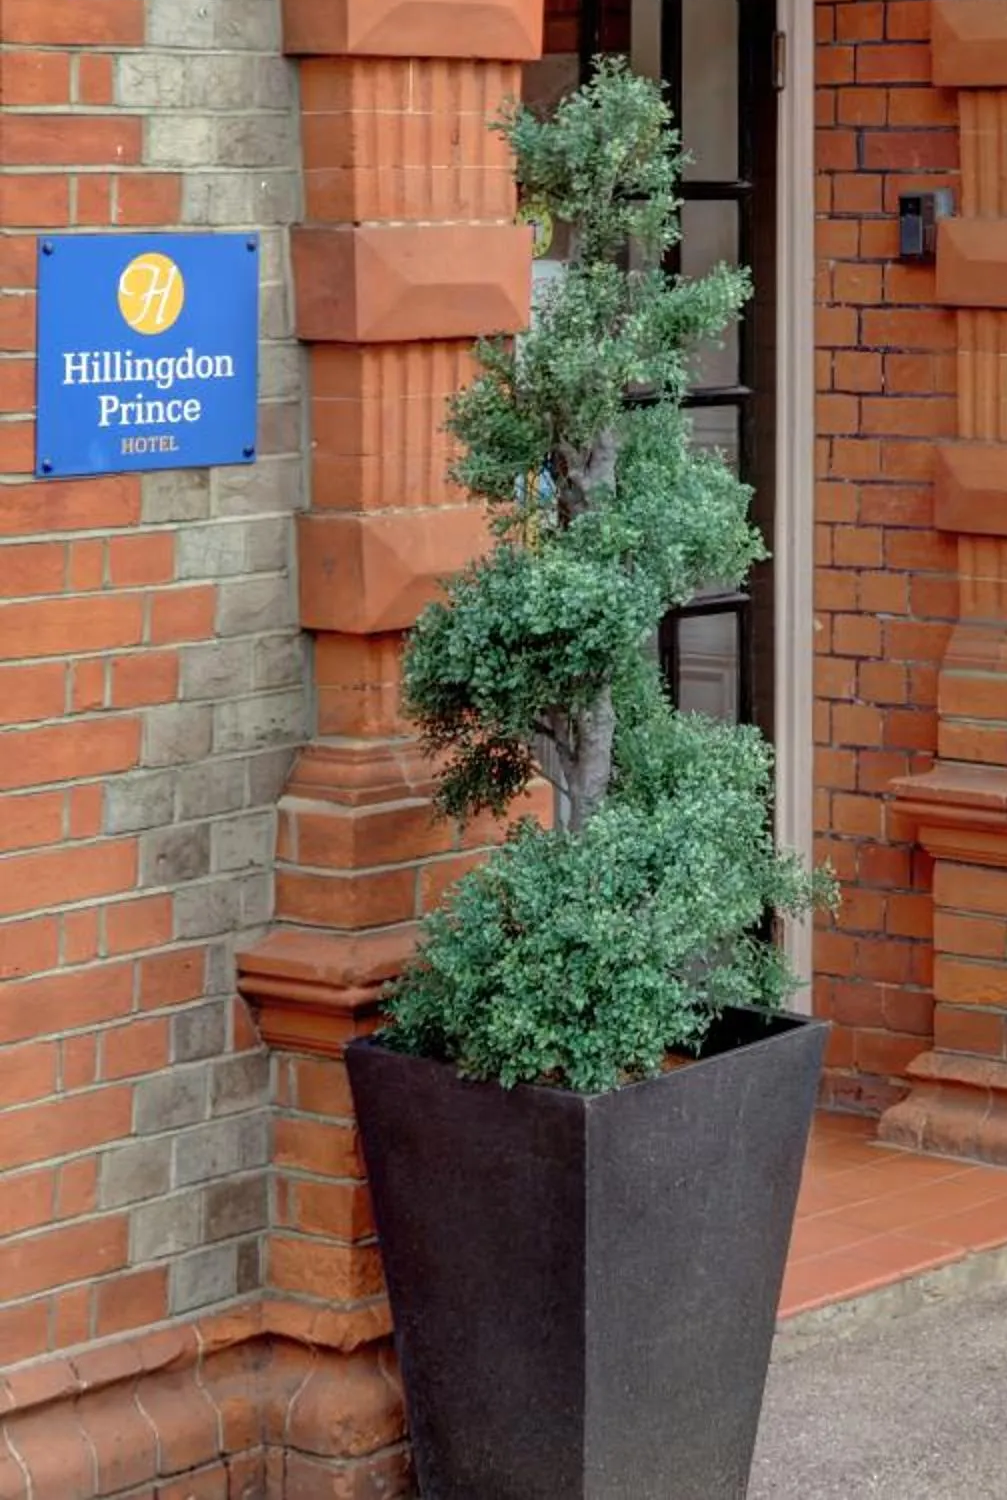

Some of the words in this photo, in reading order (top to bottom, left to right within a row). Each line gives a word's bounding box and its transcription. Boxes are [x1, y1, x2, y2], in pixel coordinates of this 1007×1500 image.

[62, 348, 234, 389] Hillingdon
[97, 393, 202, 427] Prince
[121, 436, 179, 455] HOTEL
